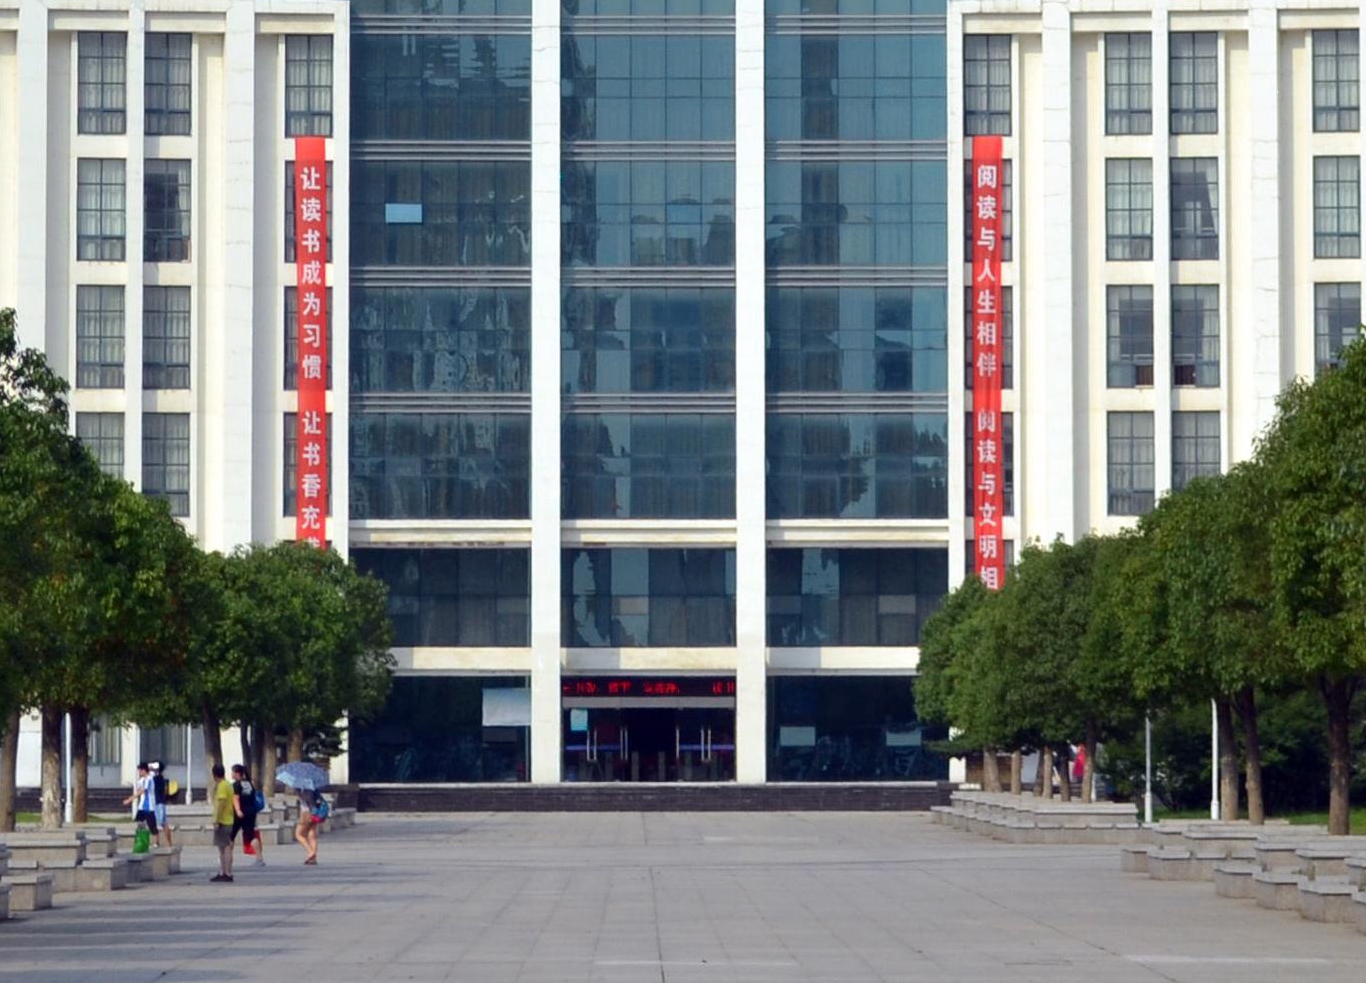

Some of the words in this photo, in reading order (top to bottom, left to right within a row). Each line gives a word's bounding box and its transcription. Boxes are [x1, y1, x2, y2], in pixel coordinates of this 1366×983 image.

[300, 166, 322, 380] 让读书成为习惯
[976, 164, 997, 377] 阅读与人生相伴
